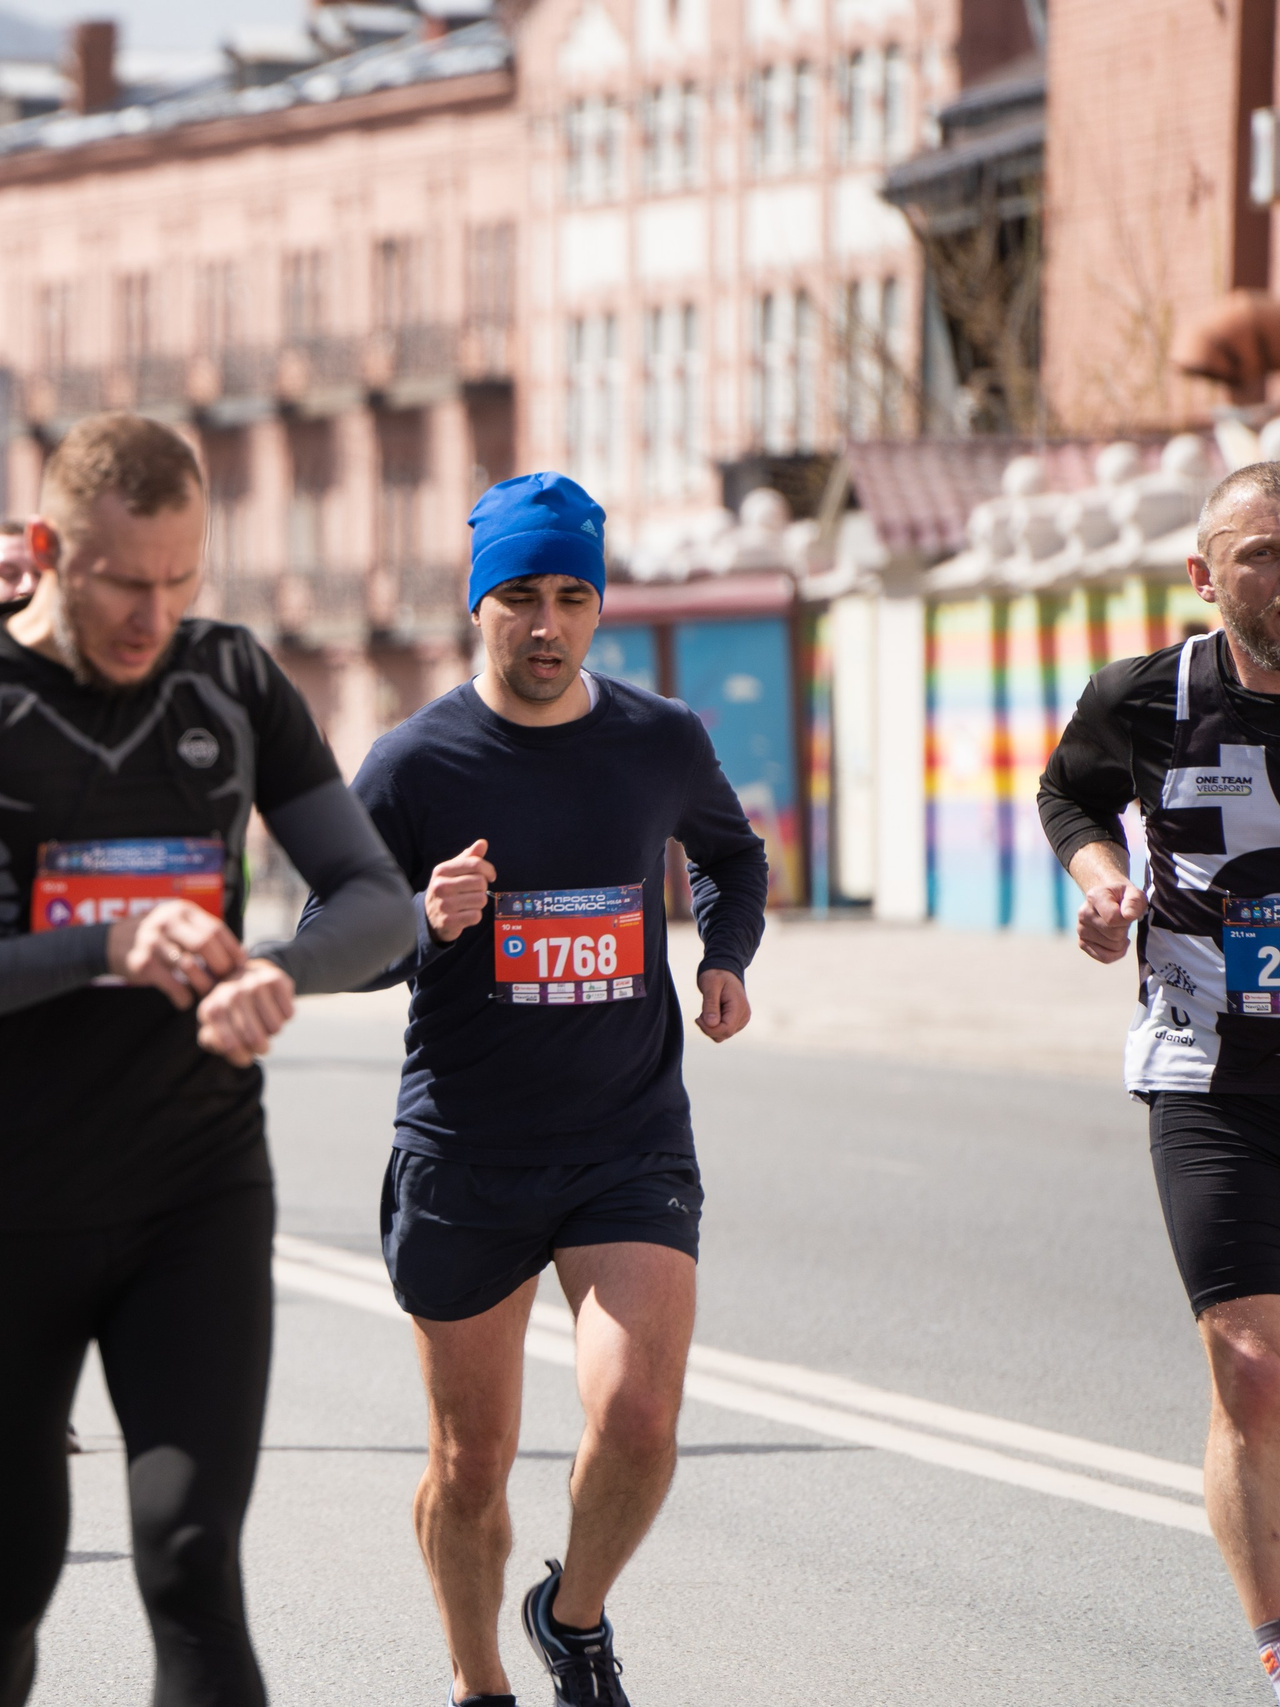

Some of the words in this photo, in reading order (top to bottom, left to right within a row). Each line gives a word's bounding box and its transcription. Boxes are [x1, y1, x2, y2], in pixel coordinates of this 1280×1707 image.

[1195, 776, 1219, 784] ONE
[1221, 776, 1253, 784] TEAM
[554, 894, 606, 903] ПРОСТО
[543, 902, 606, 912] КОСМОС
[1230, 930, 1245, 938] 21,1
[508, 940, 522, 953] D
[533, 933, 617, 978] 1768
[1155, 1031, 1196, 1047] ulandy
